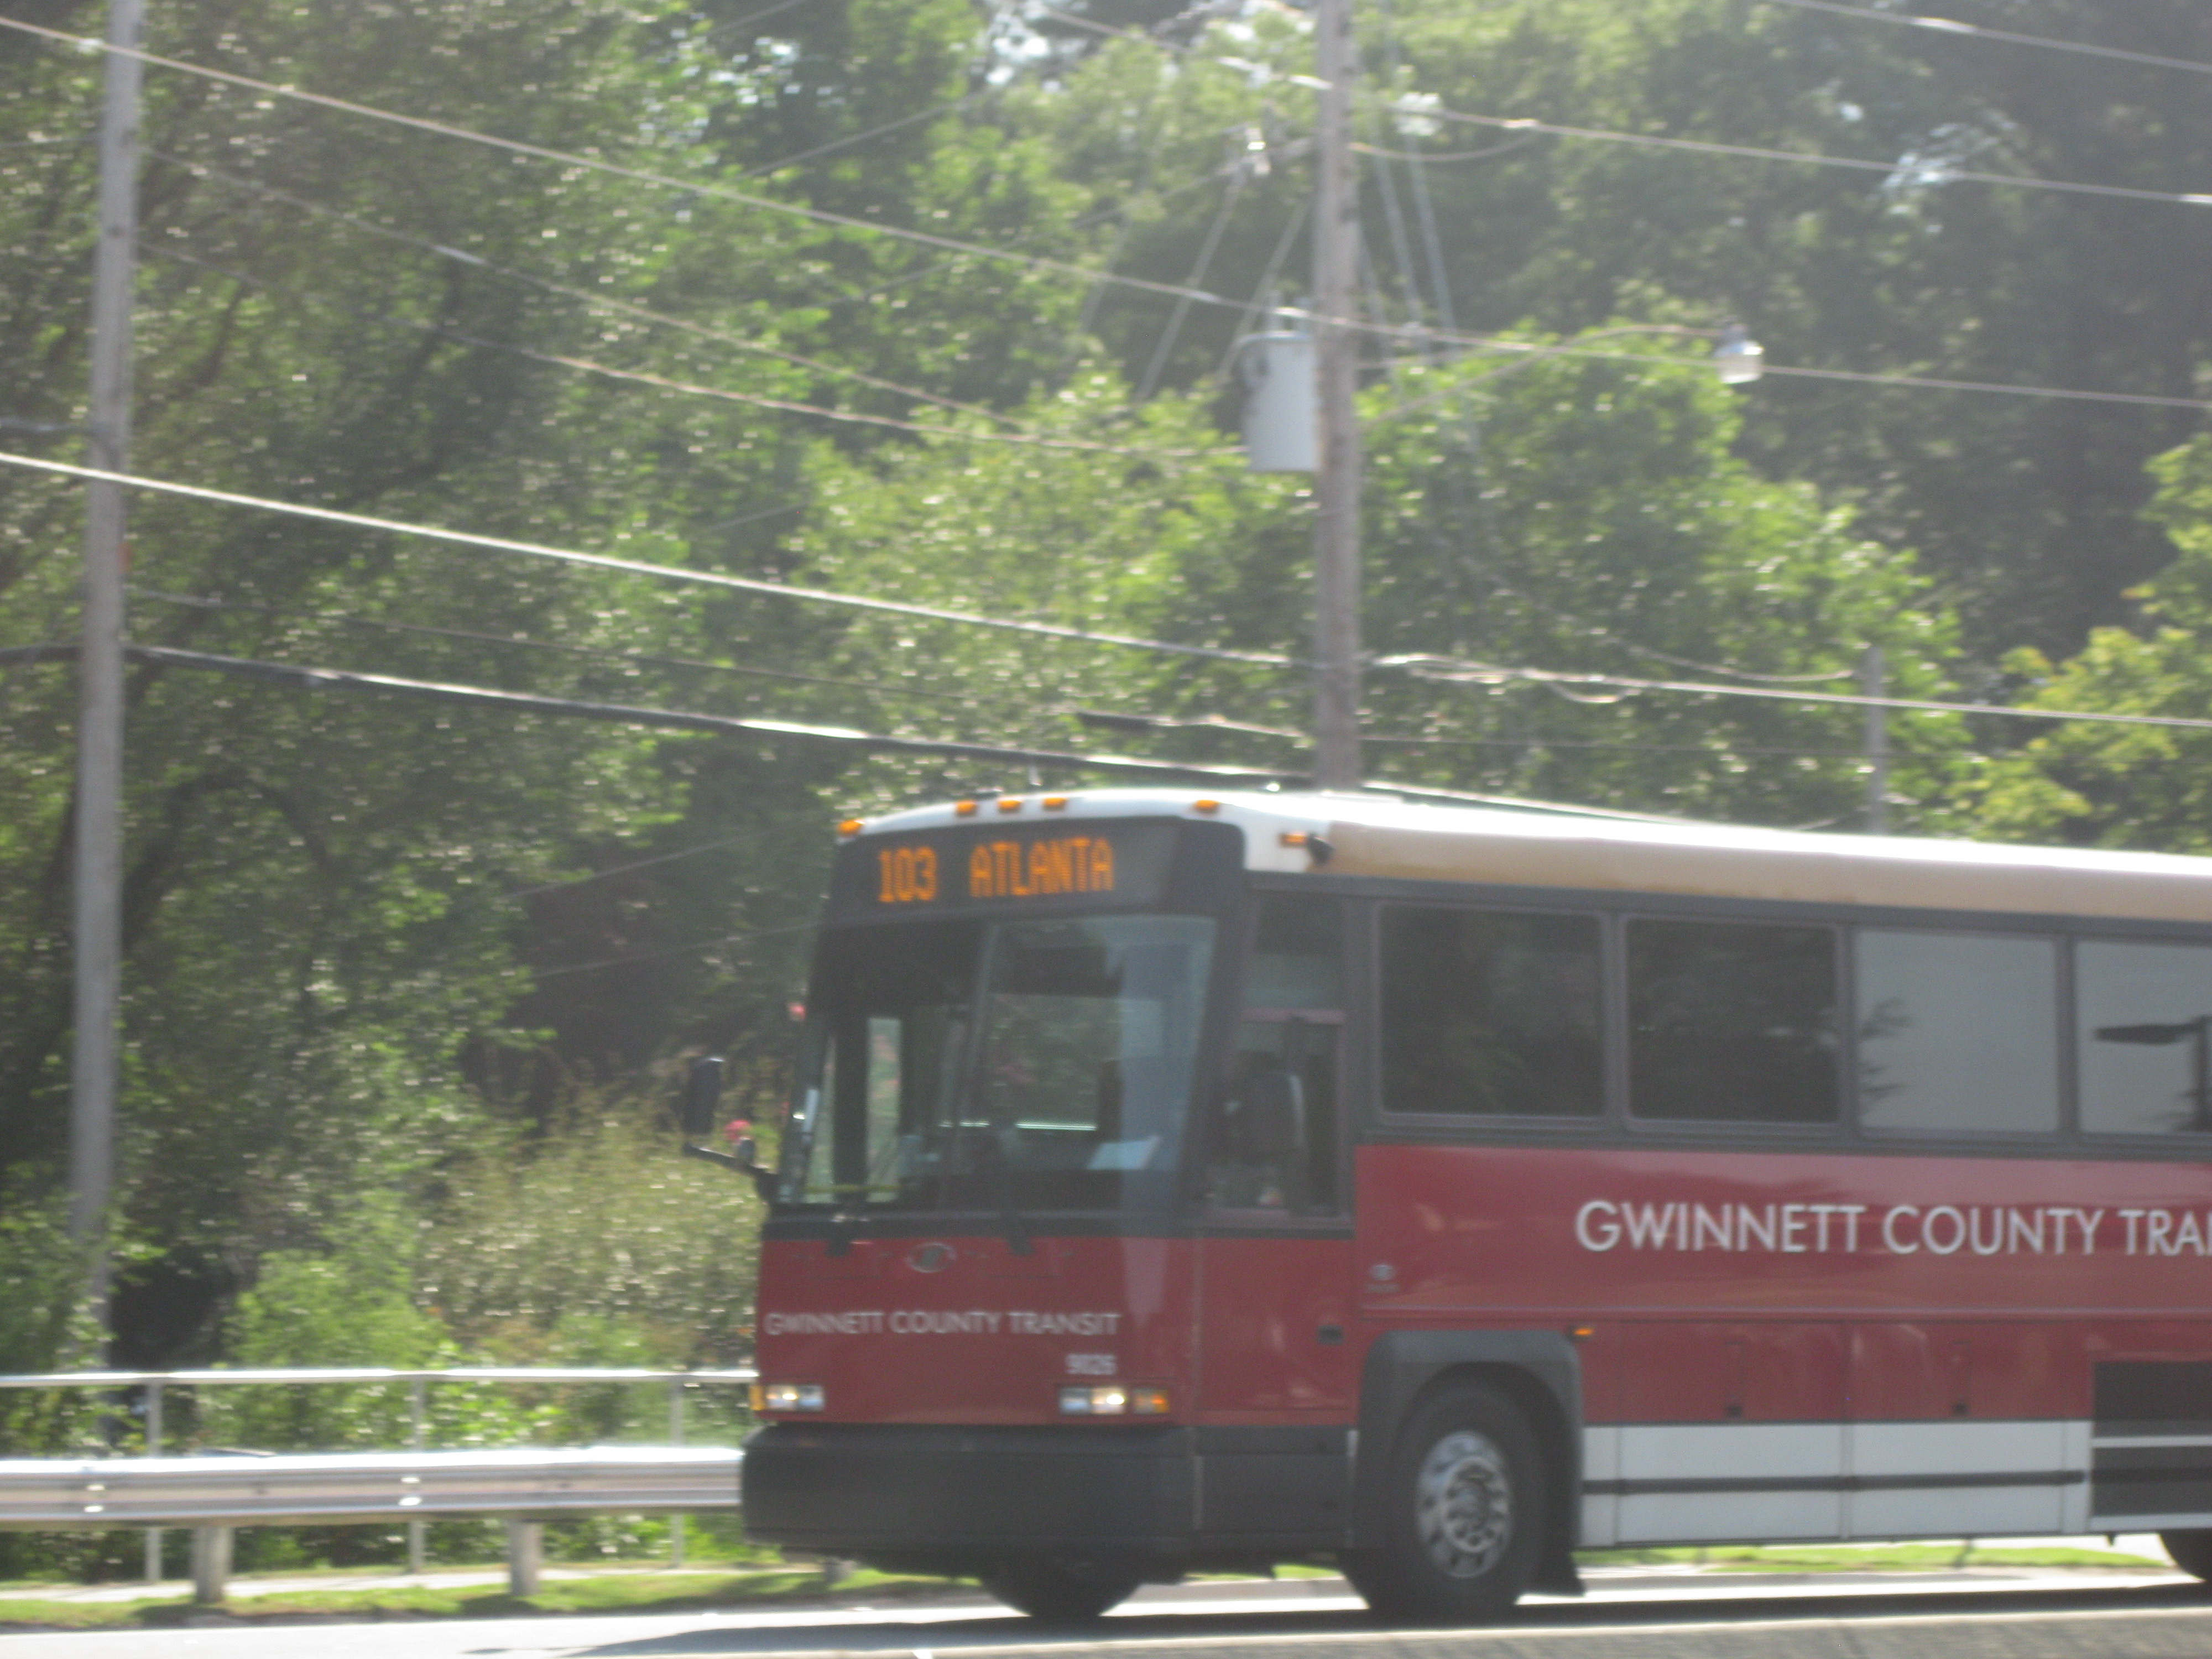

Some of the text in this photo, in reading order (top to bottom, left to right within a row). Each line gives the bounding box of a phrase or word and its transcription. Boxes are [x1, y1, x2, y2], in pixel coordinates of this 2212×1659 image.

[879, 837, 1114, 901] 103 ATLANTA
[1575, 1201, 2212, 1256] GWINNETT COUNTY TRA
[764, 1311, 1121, 1335] GWINNETT COUNTY TRANSIT
